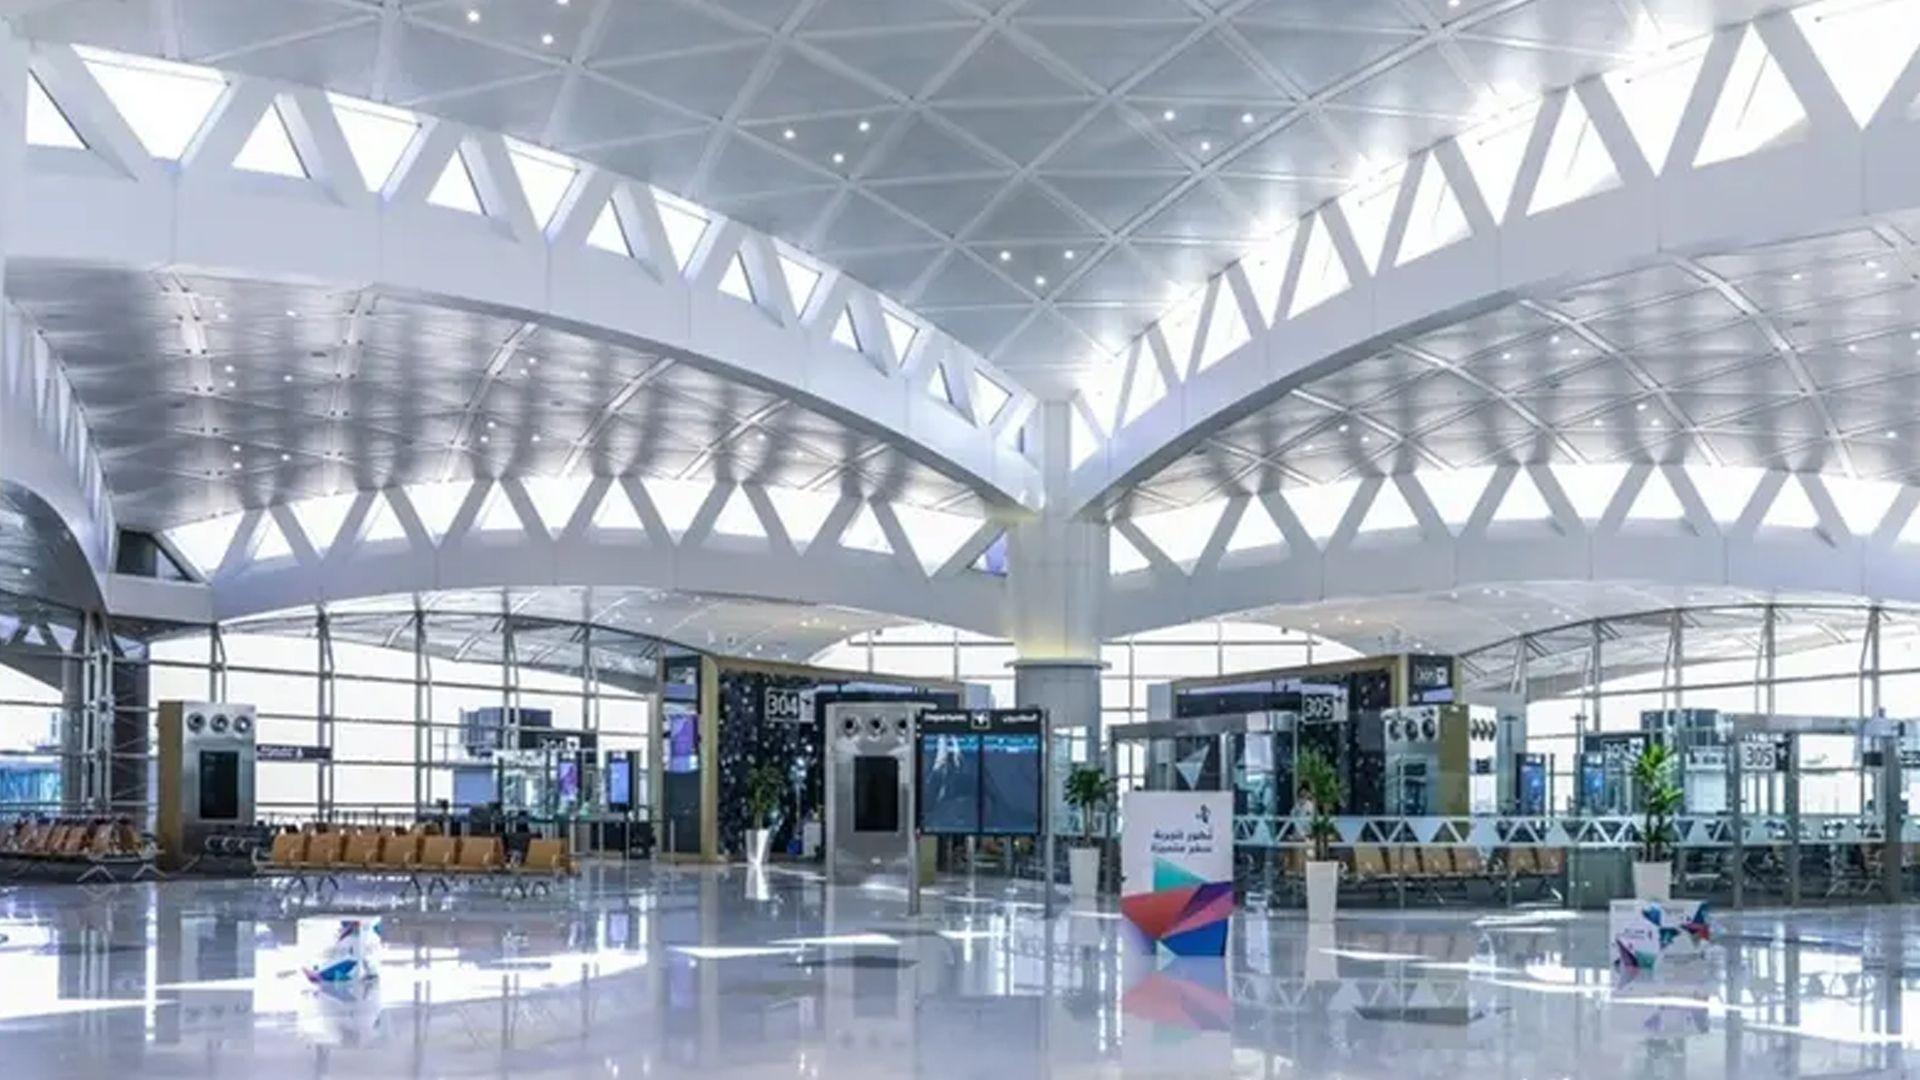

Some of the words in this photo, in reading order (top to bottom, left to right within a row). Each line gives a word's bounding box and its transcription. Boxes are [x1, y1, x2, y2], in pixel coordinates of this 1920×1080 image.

[766, 694, 798, 715] 304
[1304, 697, 1333, 718] 305
[1744, 745, 1773, 766] 305
